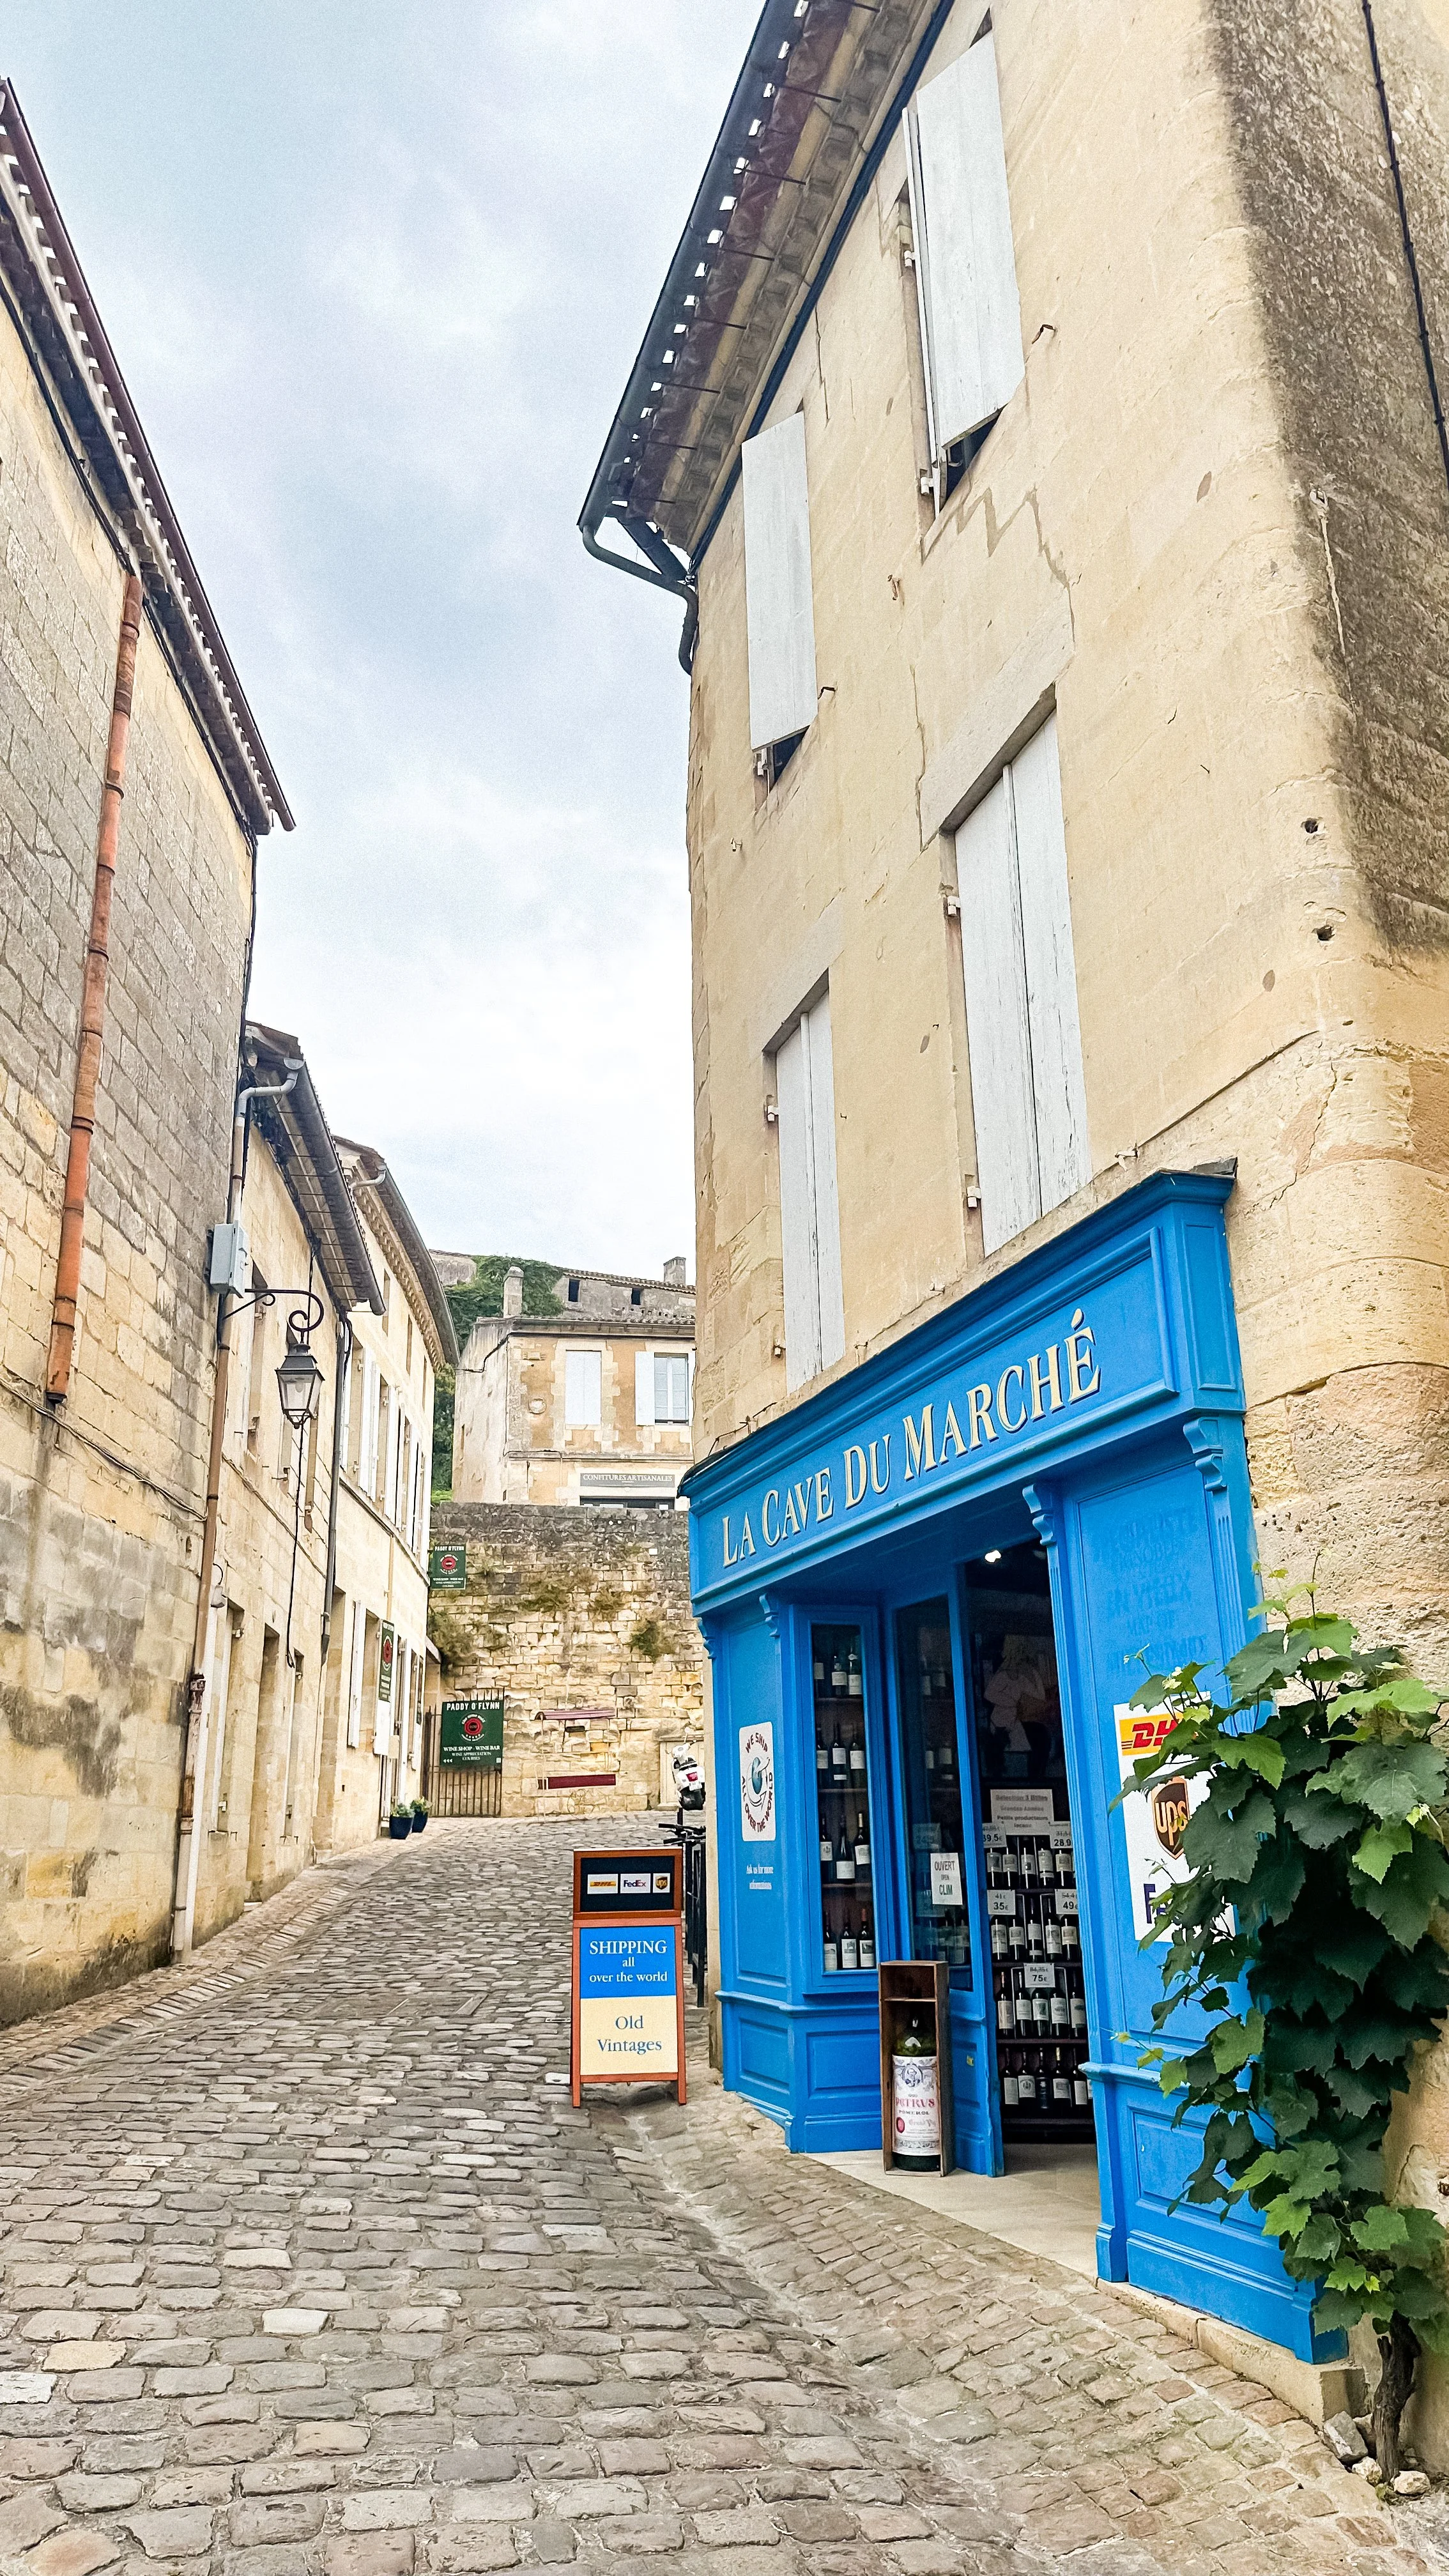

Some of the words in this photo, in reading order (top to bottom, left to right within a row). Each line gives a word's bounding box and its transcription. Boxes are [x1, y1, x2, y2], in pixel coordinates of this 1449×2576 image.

[723, 1512, 756, 1568] LA
[762, 1466, 834, 1548] CAVE
[843, 1433, 891, 1510] DU
[902, 1308, 1101, 1482] MARCHÉ
[447, 1703, 469, 1711] PADDY
[471, 1702, 500, 1710] O'FLYNN
[746, 1734, 754, 1753] WE
[755, 1732, 768, 1752] SHIP
[745, 1803, 756, 1831] OVER
[756, 1818, 765, 1832] THE
[765, 1772, 773, 1821] WORLD
[934, 1860, 955, 1871] OUVERT
[656, 1880, 668, 1888] ups
[939, 1884, 953, 1896] CLIM
[993, 1901, 1009, 1911] 35€
[589, 1939, 668, 1955] SHIPPING
[622, 1957, 634, 1967] all
[589, 1973, 613, 1982] over
[617, 1972, 633, 1982] the
[636, 1971, 668, 1982] world
[615, 2015, 644, 2030] Old
[597, 2038, 662, 2055] Vintages
